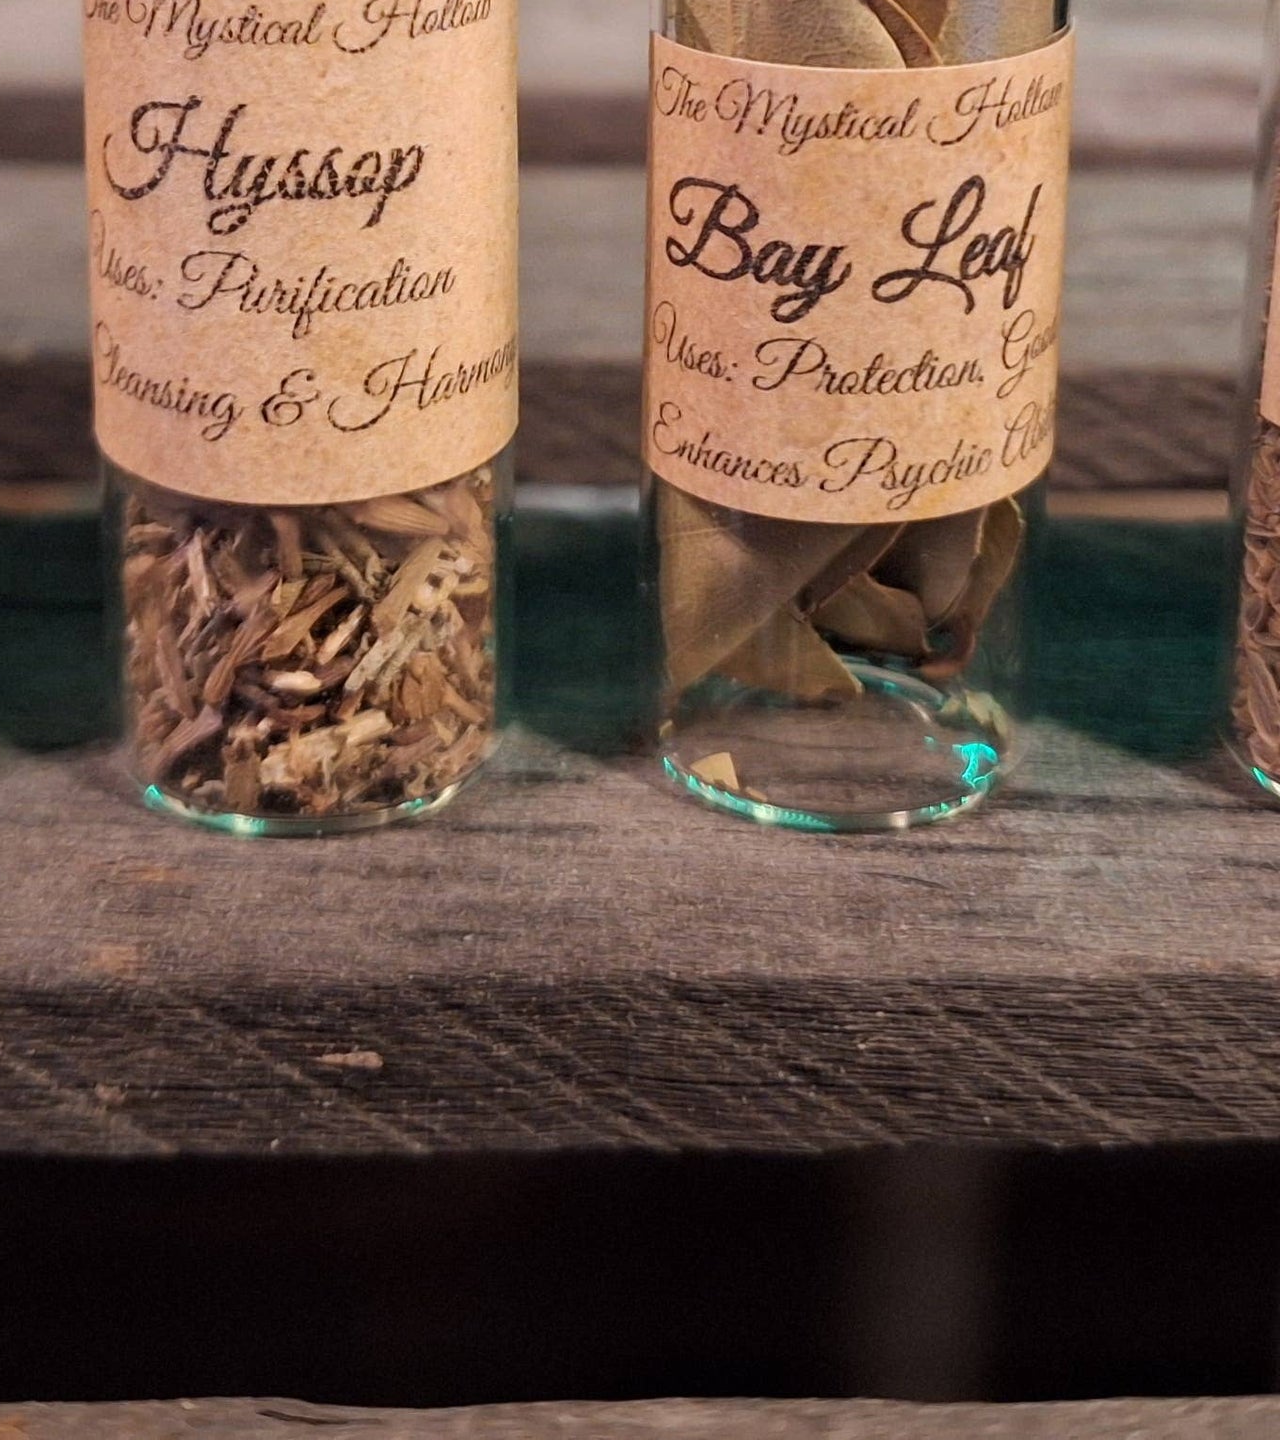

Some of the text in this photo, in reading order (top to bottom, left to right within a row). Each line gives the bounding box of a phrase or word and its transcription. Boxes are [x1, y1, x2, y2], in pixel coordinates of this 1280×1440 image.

[103, 95, 426, 235] Hyssop
[657, 67, 1063, 156] The Mystical Hollow
[91, 209, 457, 340] Uses: Purification
[665, 175, 1042, 324] Bay Leaf
[653, 301, 737, 382] Uses:
[261, 369, 319, 426] &
[653, 402, 992, 510] Enhances Psychic
